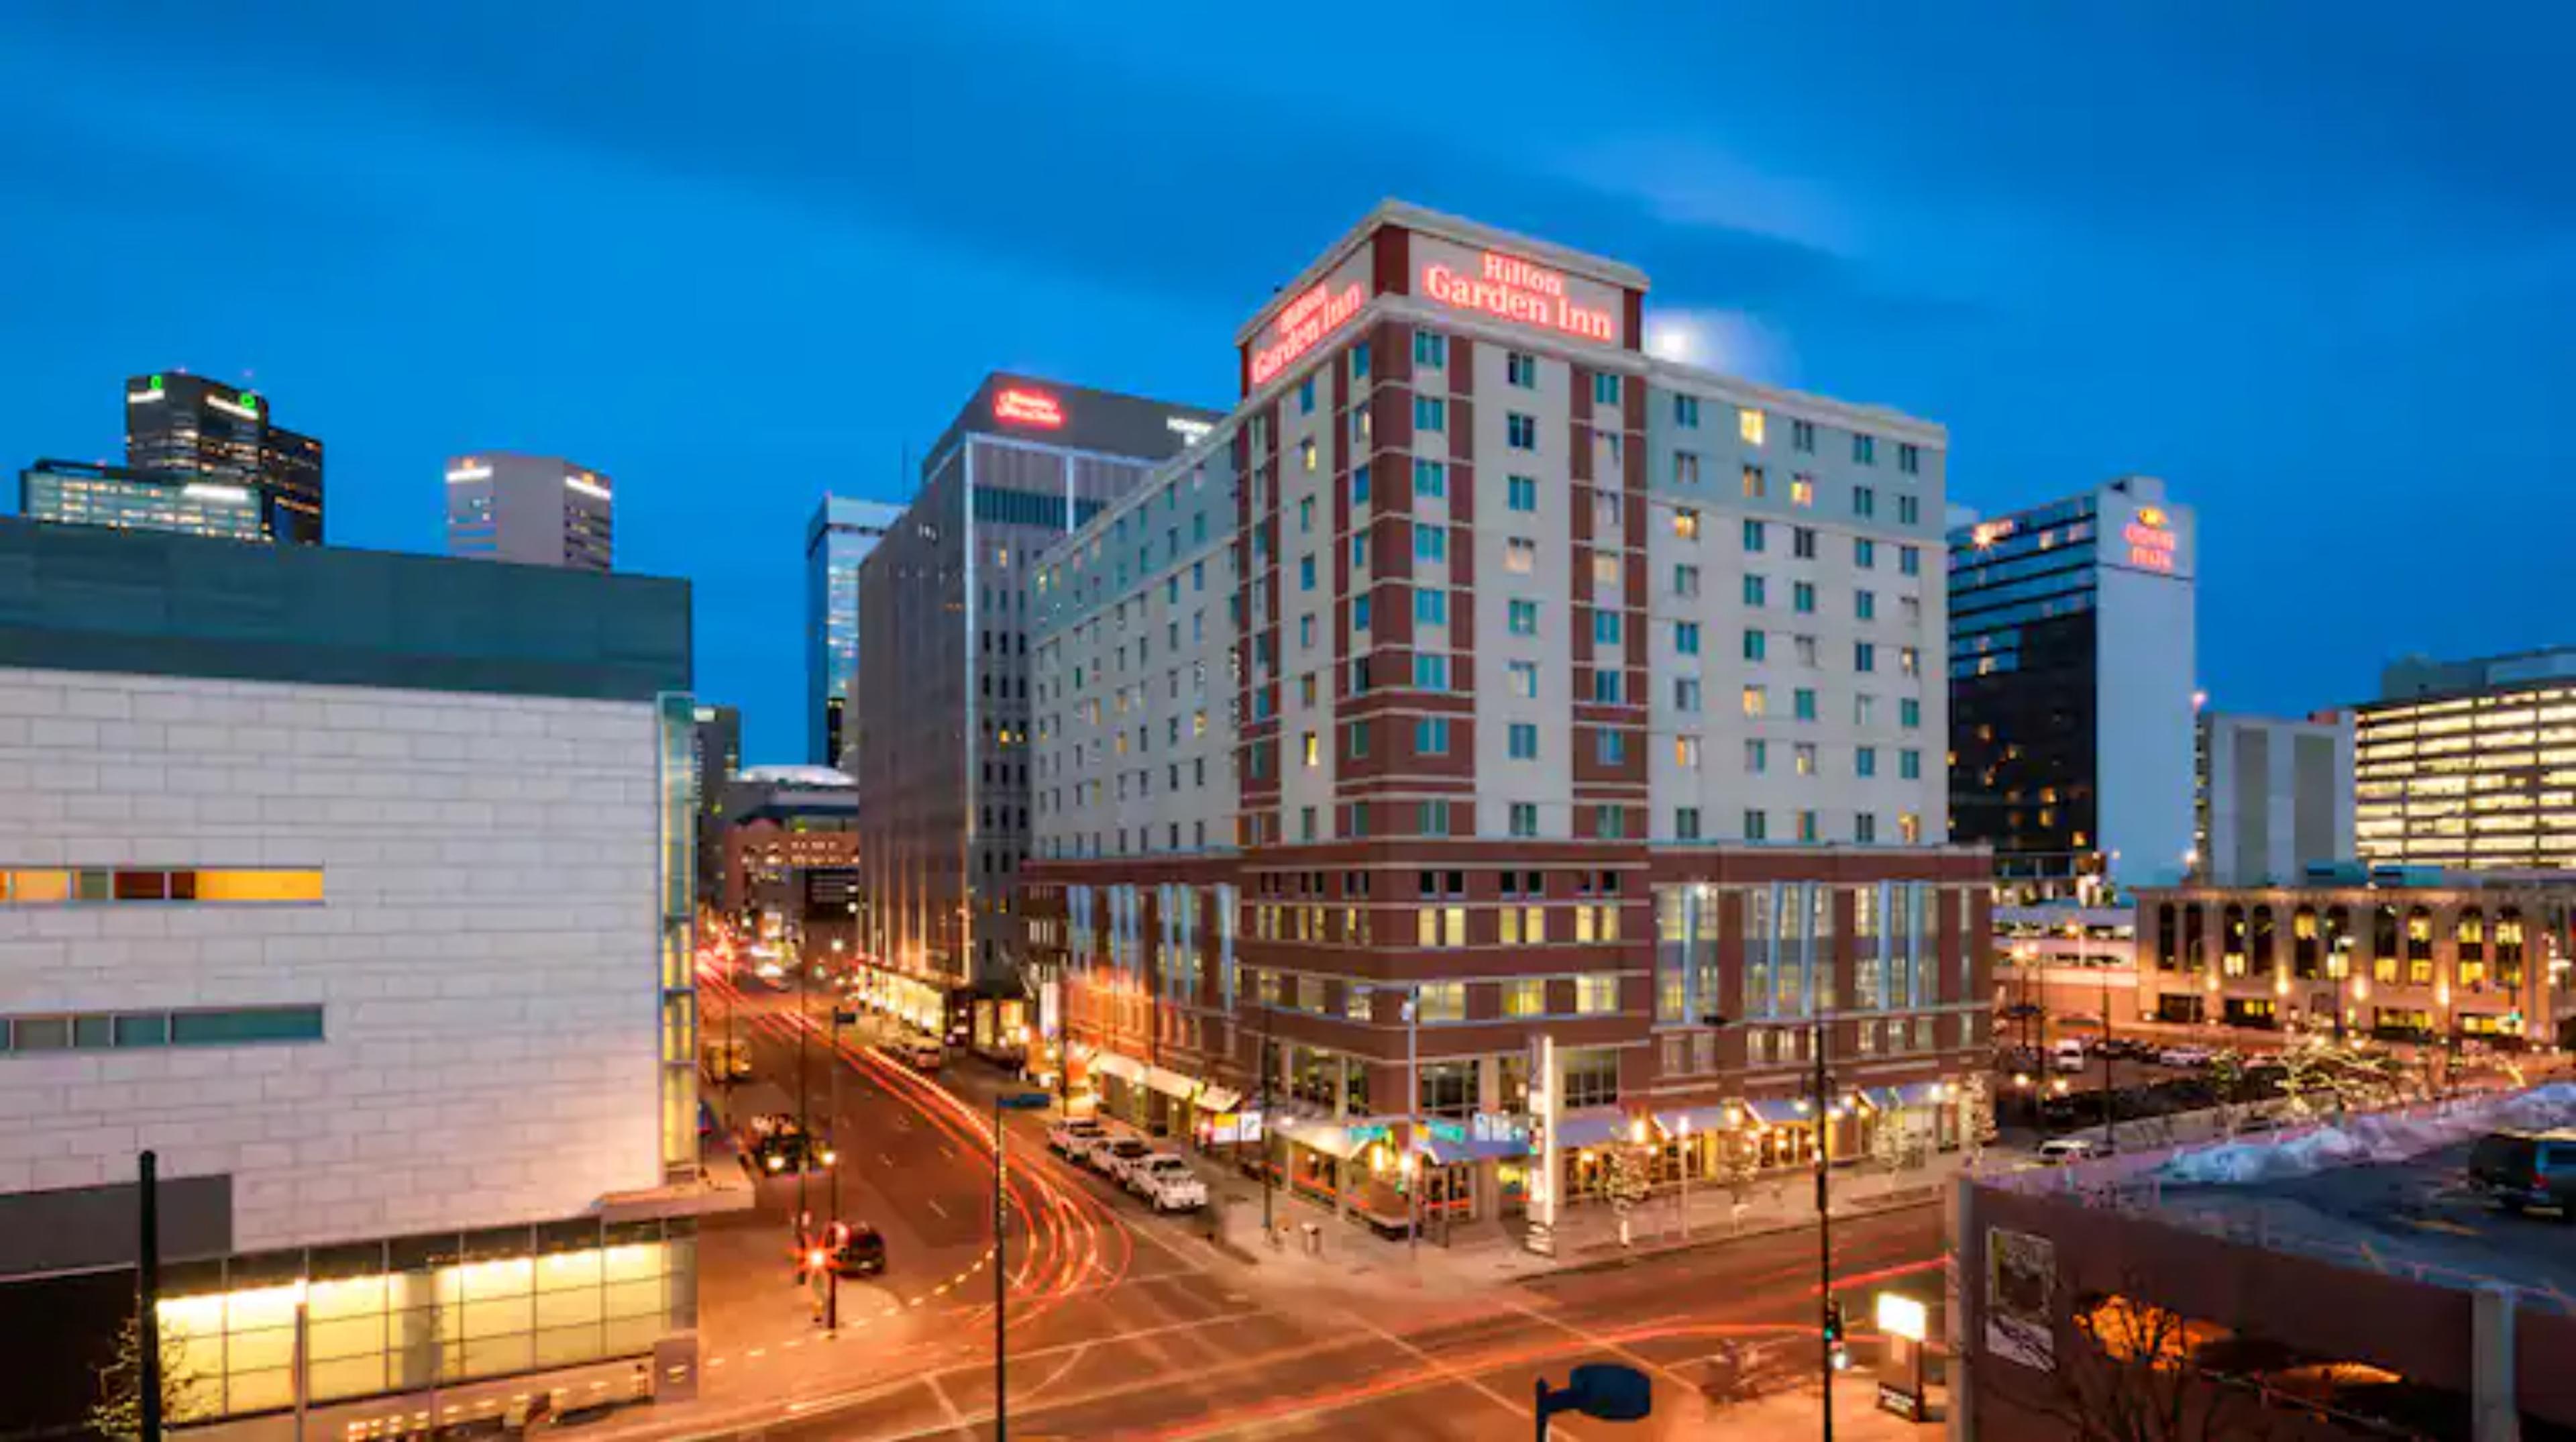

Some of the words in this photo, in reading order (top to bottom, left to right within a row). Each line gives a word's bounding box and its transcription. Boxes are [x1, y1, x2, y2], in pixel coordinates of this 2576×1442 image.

[1484, 252, 1562, 295] Hilton
[1323, 282, 1361, 334] Inn
[1427, 264, 1548, 325] Garden
[1558, 295, 1613, 340] Inn
